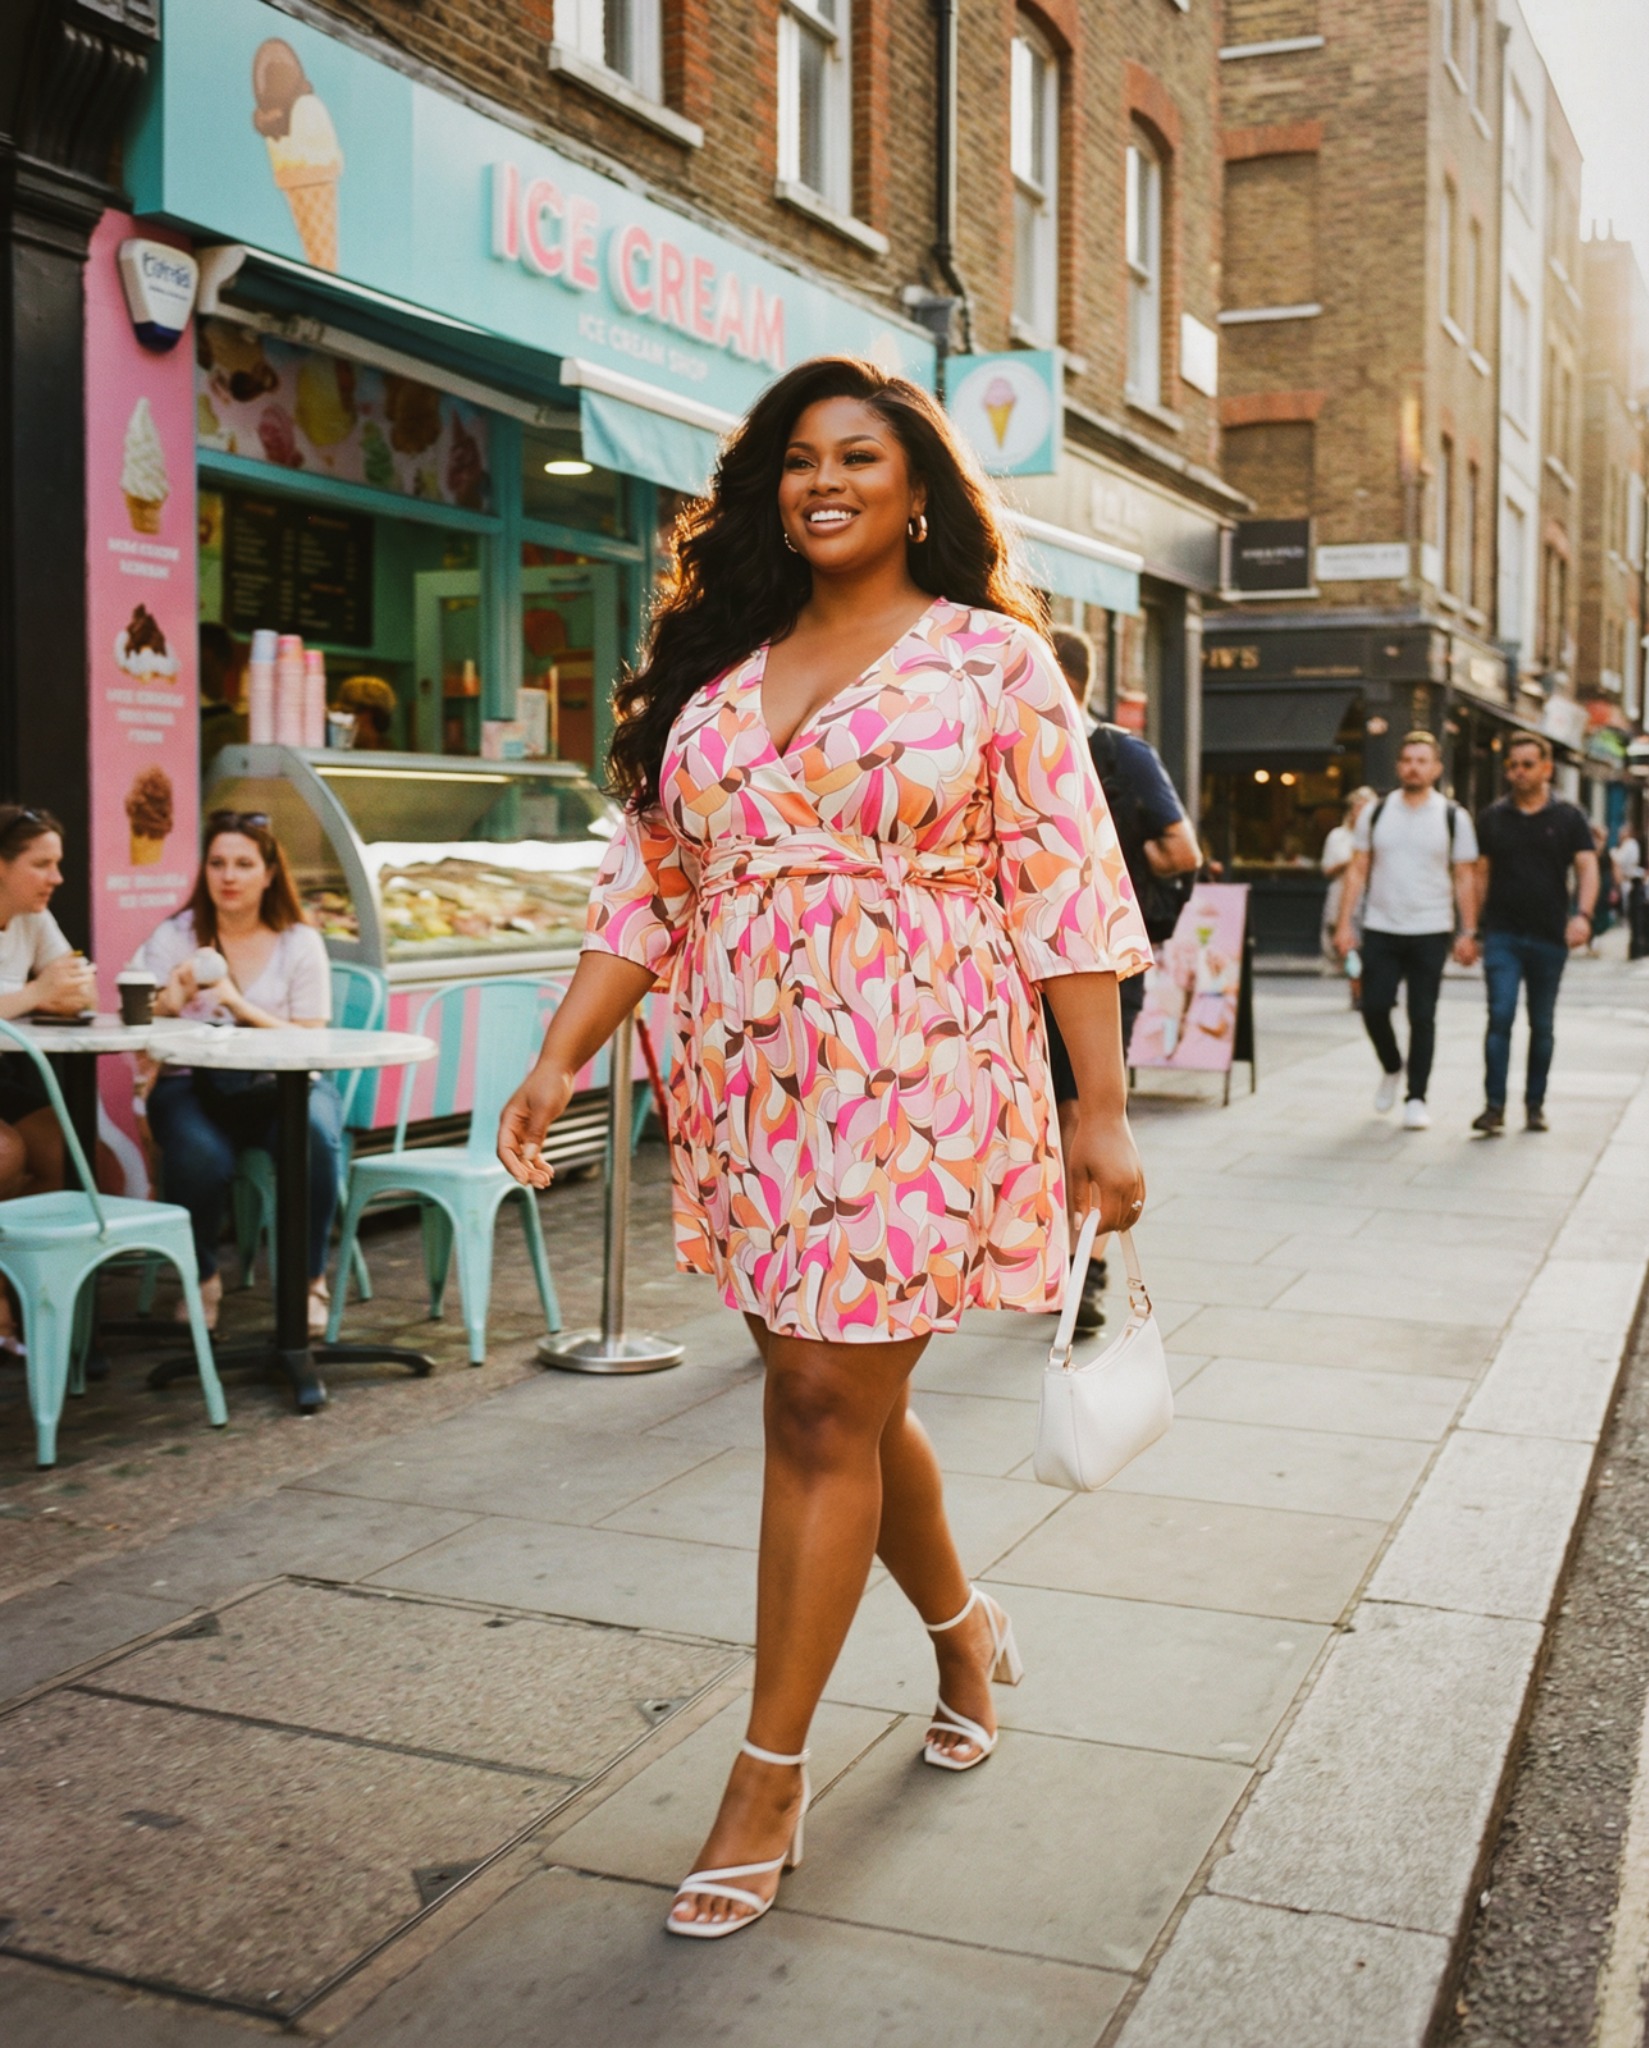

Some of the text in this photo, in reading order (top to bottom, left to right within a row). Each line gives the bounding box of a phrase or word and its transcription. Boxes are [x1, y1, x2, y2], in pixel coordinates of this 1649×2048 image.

[494, 162, 787, 371] ICE CREAM
[578, 312, 606, 346] ICE
[609, 323, 665, 367] CREAM
